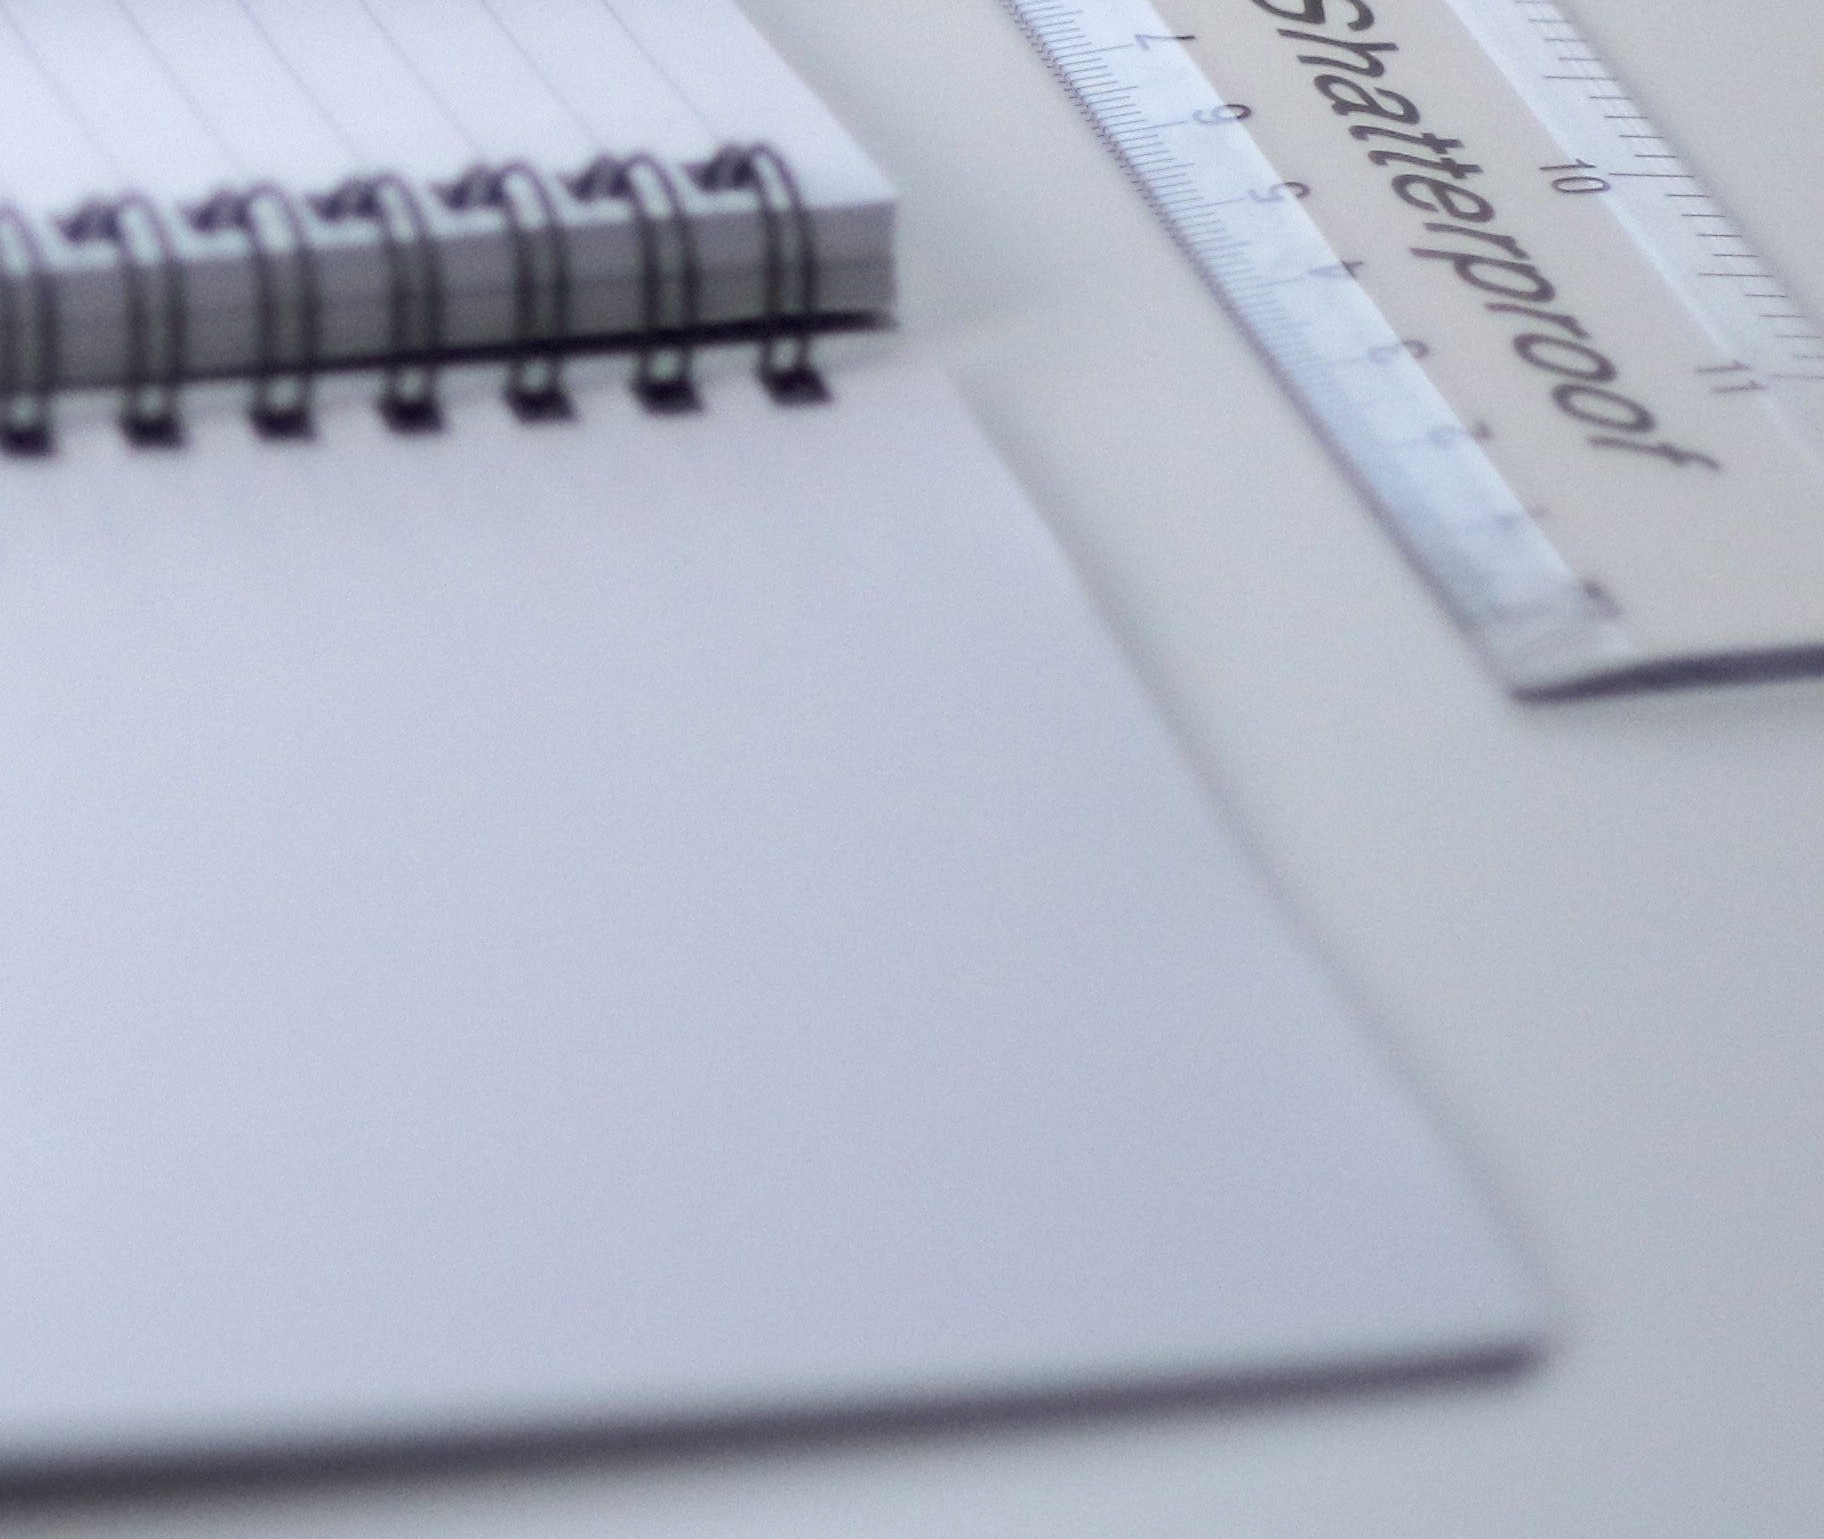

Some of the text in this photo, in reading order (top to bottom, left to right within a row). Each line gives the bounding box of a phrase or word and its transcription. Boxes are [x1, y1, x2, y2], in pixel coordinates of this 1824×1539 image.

[1134, 32, 1197, 53] 7
[1192, 102, 1252, 128] 6
[1248, 179, 1311, 206] 5
[1307, 259, 1364, 281] 4
[1367, 338, 1431, 365] 3
[1538, 158, 1611, 196] 10
[1694, 360, 1768, 394] 11
